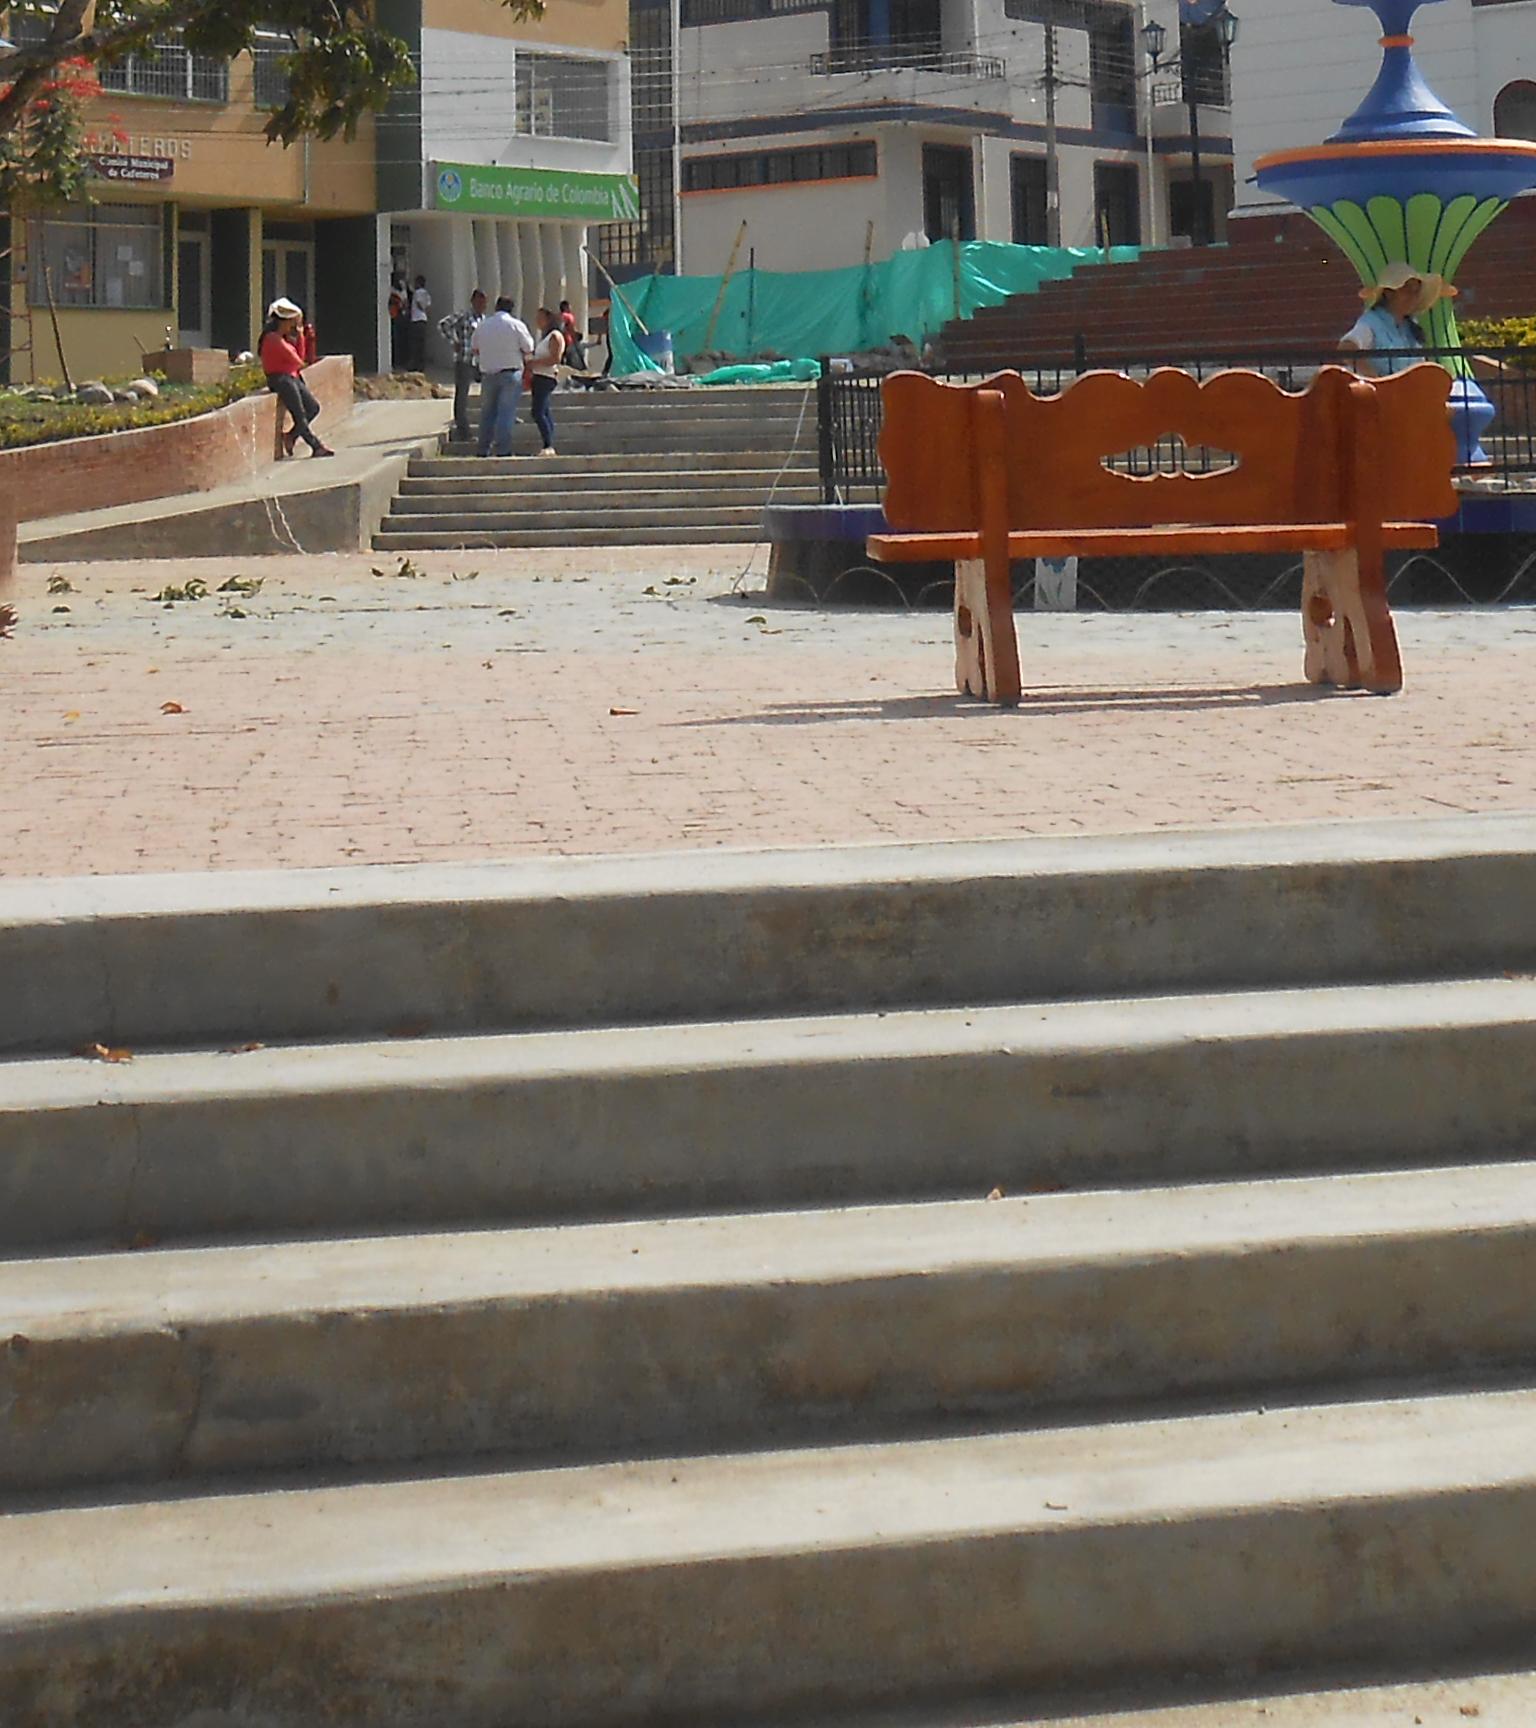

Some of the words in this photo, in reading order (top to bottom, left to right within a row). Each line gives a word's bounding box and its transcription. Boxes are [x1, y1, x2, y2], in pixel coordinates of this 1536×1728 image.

[99, 156, 128, 166] Cmité
[131, 158, 169, 171] Municipal
[120, 168, 160, 180] Cafeteros
[470, 178, 503, 199] Banco
[506, 181, 544, 205] Agrario
[546, 184, 559, 202] de
[562, 184, 609, 204] Colombia
